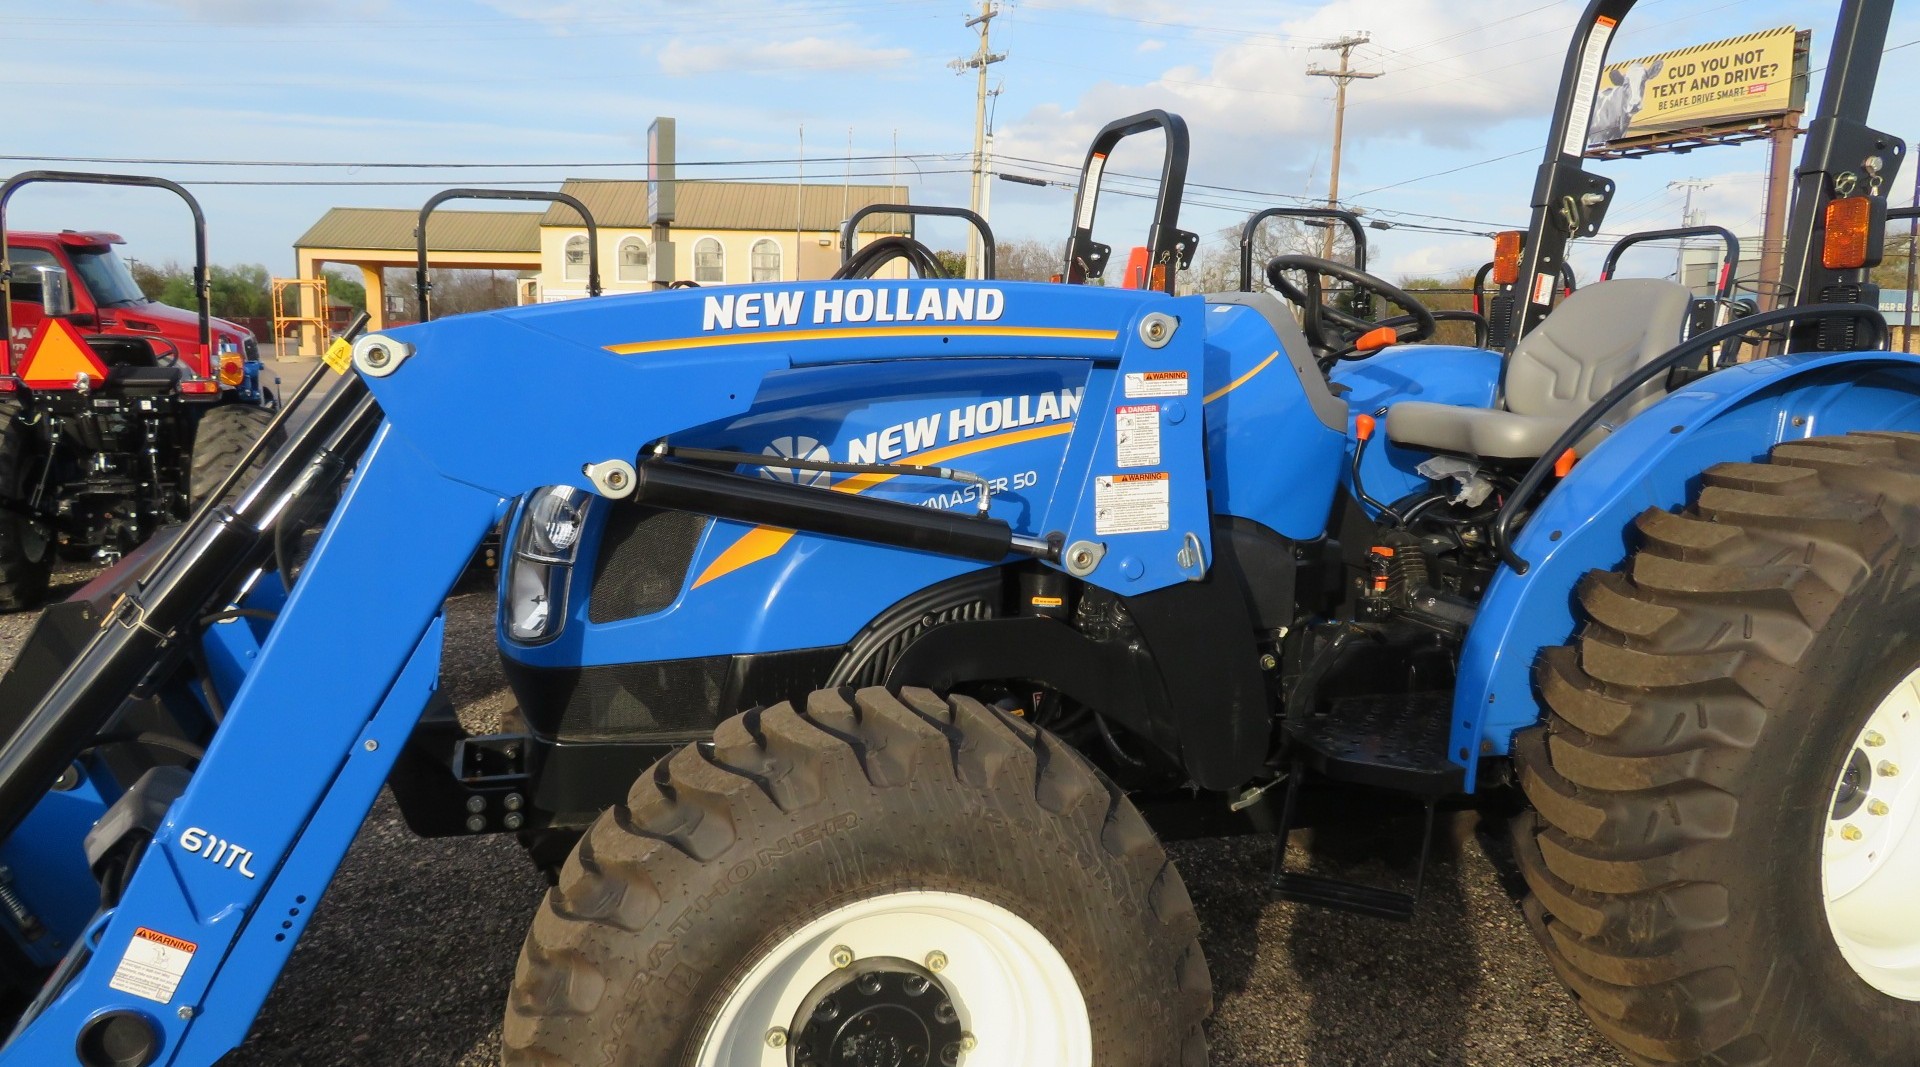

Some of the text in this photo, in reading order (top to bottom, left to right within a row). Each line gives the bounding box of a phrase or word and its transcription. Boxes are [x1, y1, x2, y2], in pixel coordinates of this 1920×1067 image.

[1668, 49, 1765, 80] CUD YOU NOT
[1652, 63, 1779, 98] TEXT AND DRIVE?
[1658, 101, 1668, 111] BE
[1691, 92, 1715, 104] DRIVE
[703, 288, 1005, 331] NEW HOLLAND
[1153, 372, 1186, 380] WARNING
[1127, 405, 1157, 413] DANGER
[848, 412, 941, 463] NEW
[949, 386, 1085, 442] HOLLAN
[1013, 470, 1037, 490] 50
[1128, 472, 1162, 481] WARNING
[179, 827, 256, 879] 611TL
[148, 931, 195, 953] WARNING
